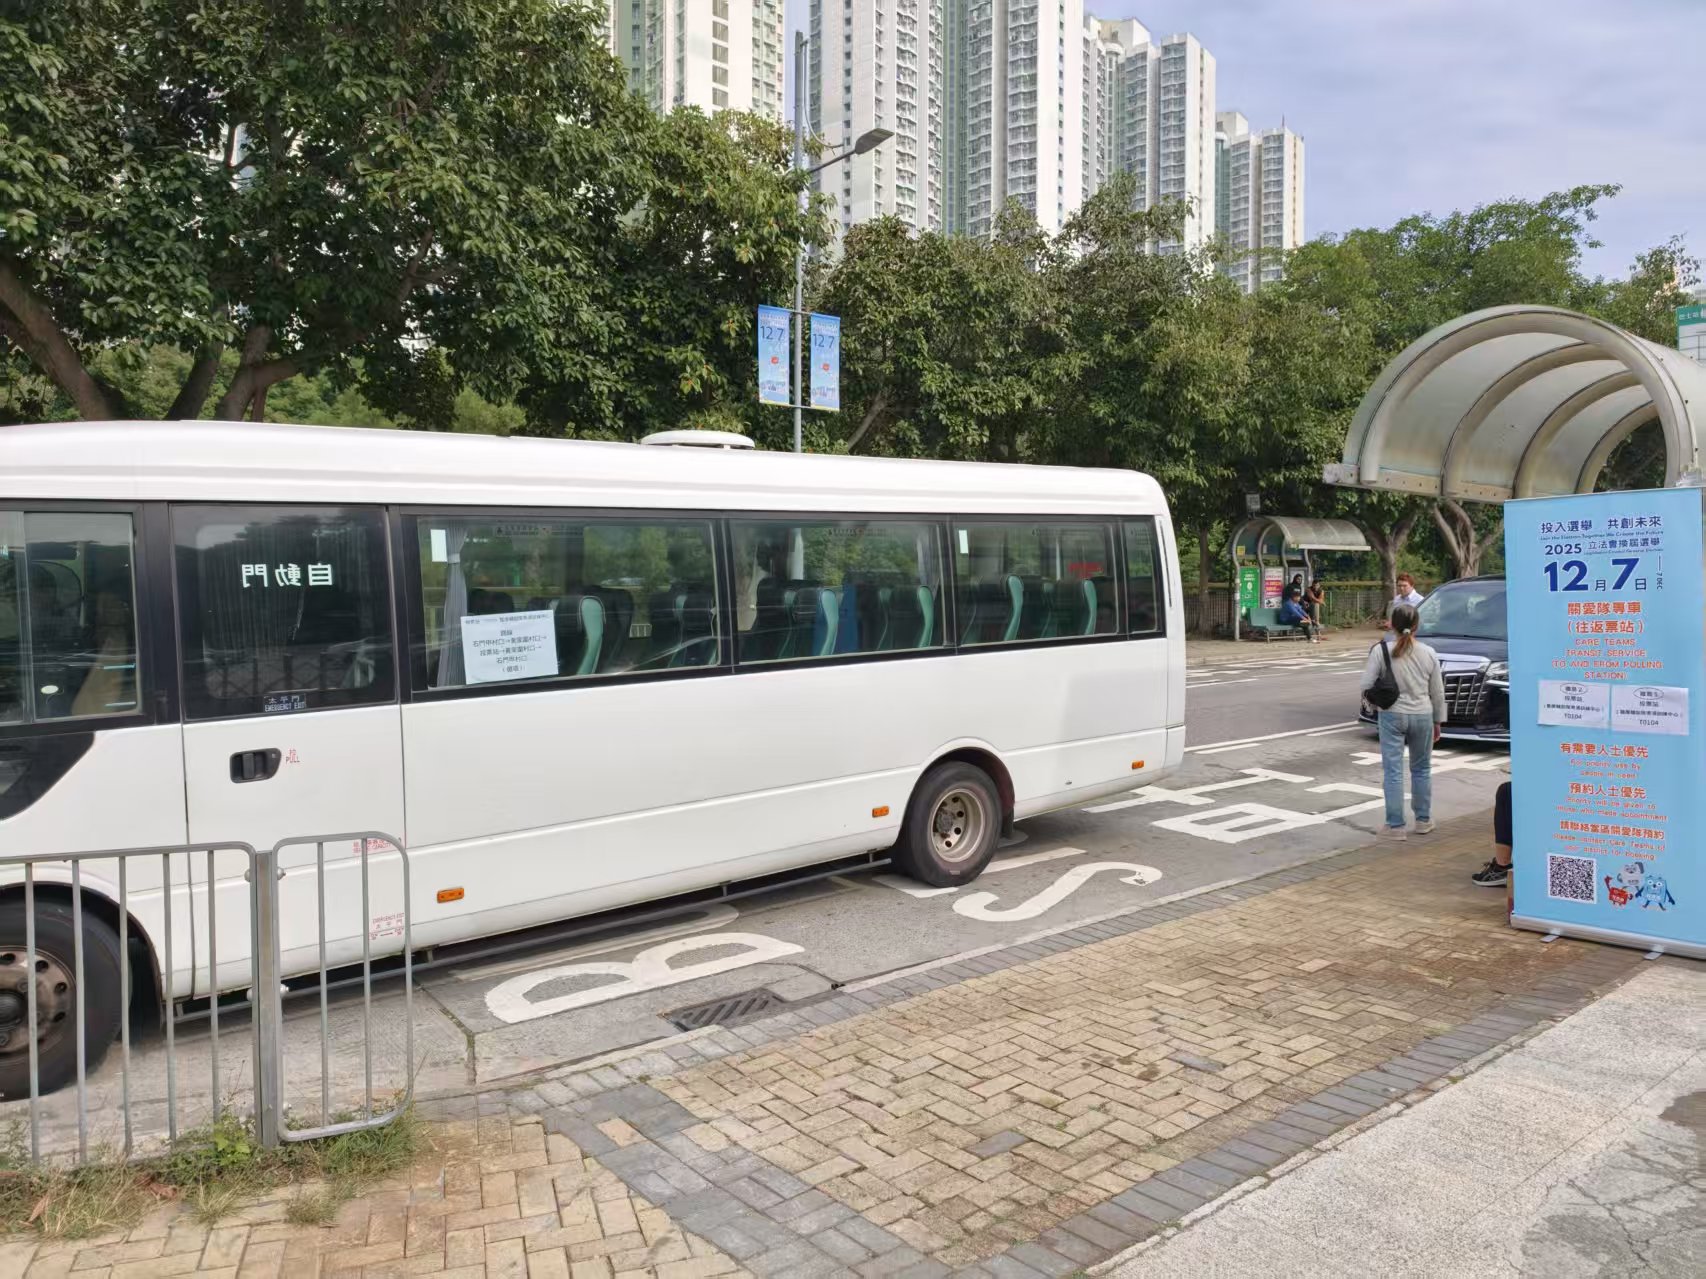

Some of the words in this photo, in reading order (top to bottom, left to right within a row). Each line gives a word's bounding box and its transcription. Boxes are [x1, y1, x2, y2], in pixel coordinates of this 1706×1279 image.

[760, 325, 774, 340] 12
[812, 333, 824, 348] 12
[1541, 519, 1593, 533] 投入選舉
[1607, 516, 1662, 530] 共創未來
[1544, 543, 1582, 555] 2025
[1588, 537, 1660, 549] 立法會換屆選舉
[1567, 601, 1642, 616] 關愛隊專車
[1575, 638, 1600, 646] CARE
[1604, 638, 1636, 646] TEAMS
[1567, 649, 1601, 657] TRANSIT
[1607, 649, 1646, 657] SERVICE
[1570, 660, 1590, 668] AND
[1593, 660, 1619, 668] FROM
[1623, 661, 1662, 669] POLLING
[1560, 743, 1649, 759] 有需要人士優先
[1570, 782, 1646, 800] 預約人士優先
